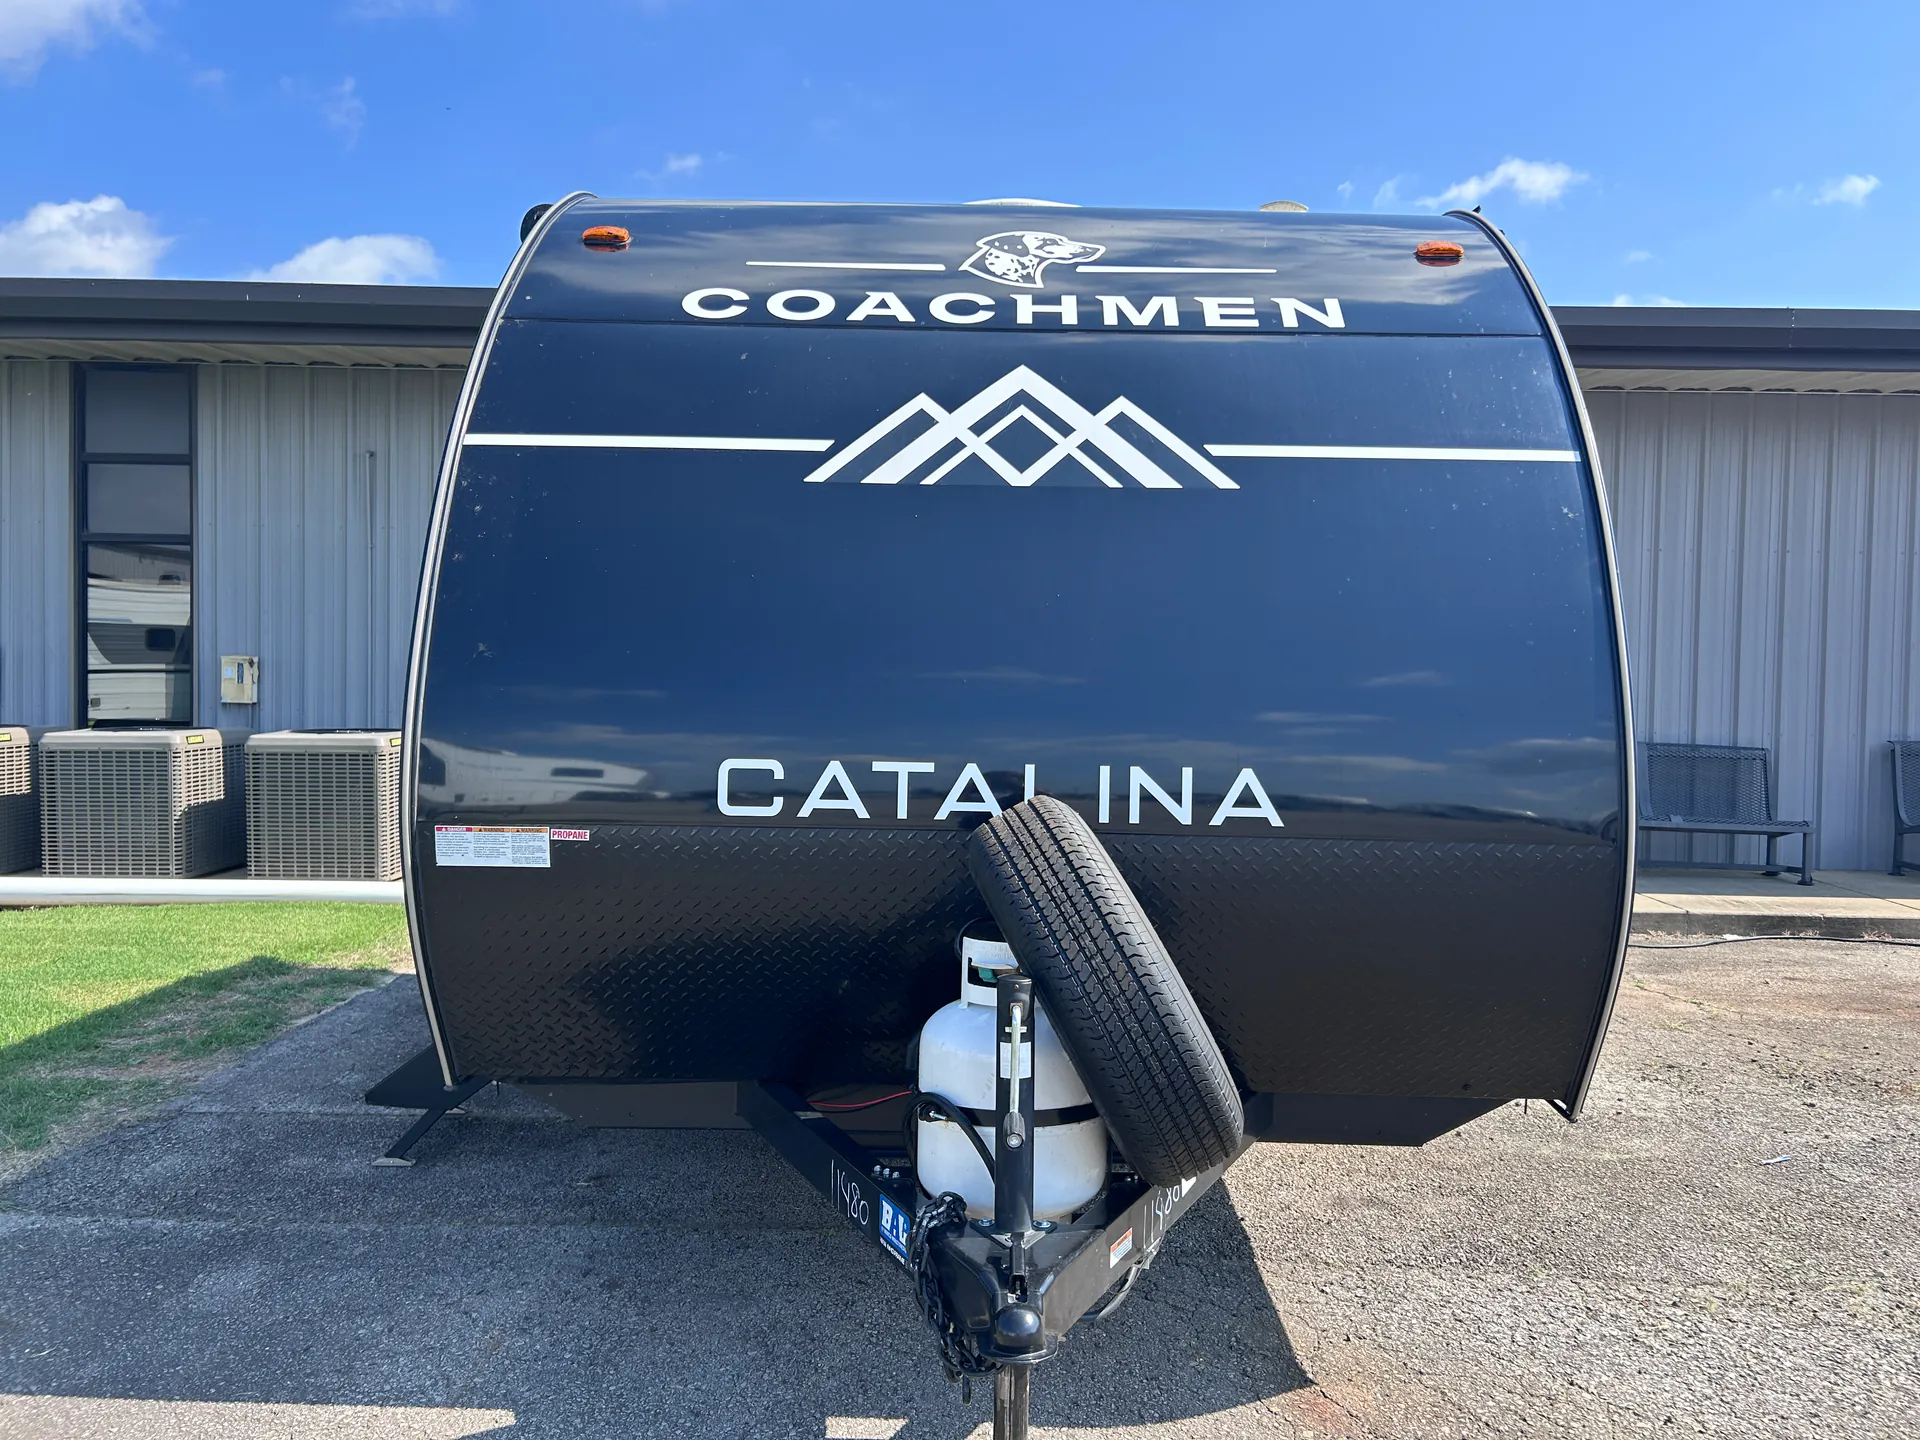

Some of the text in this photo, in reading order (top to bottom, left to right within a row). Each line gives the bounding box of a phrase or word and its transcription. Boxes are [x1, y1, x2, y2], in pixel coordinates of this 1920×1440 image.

[680, 287, 1346, 329] COACHMEN
[552, 830, 588, 839] PROPANE
[831, 1159, 870, 1225] 11480
